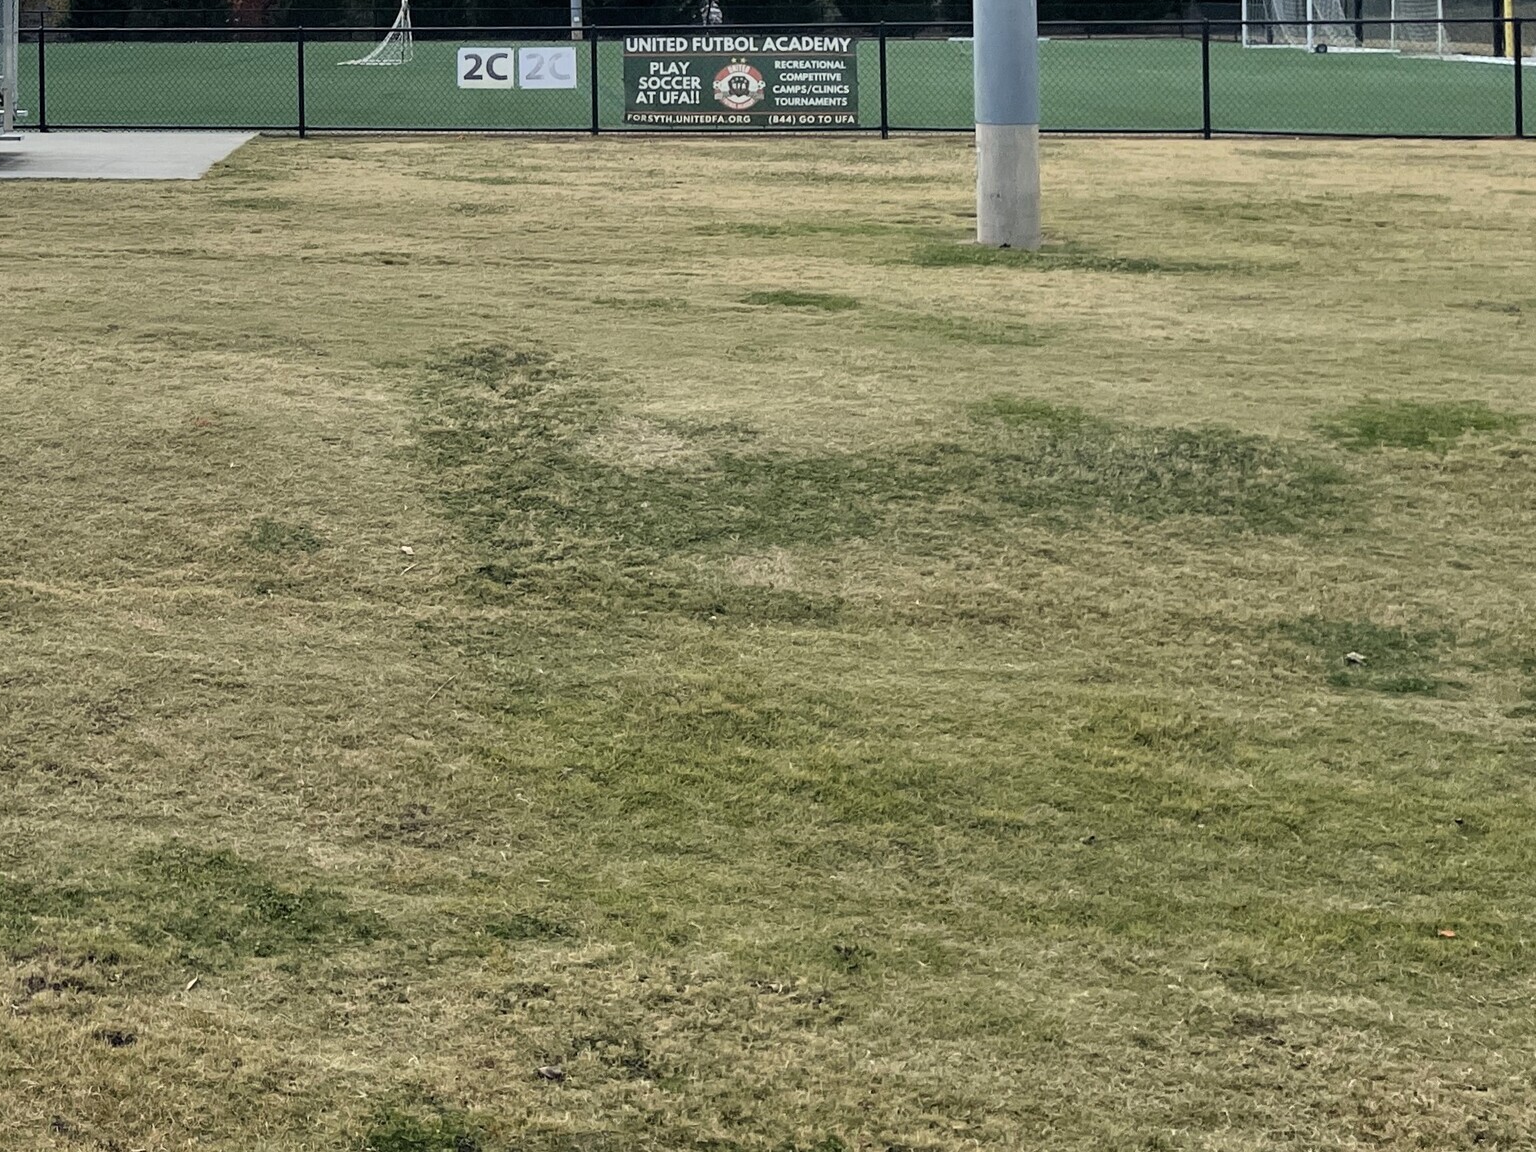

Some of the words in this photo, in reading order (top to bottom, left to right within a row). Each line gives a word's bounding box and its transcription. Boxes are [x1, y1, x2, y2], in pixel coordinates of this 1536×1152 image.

[626, 37, 688, 52] UNITED
[692, 36, 758, 52] FUTBOL
[762, 36, 851, 52] ACADEMY
[464, 53, 508, 80] 2C
[525, 53, 571, 80] 2C
[649, 62, 690, 75] PLAY
[774, 60, 846, 69] RECREATIONAL
[779, 73, 842, 81] COMPETITIVE
[638, 76, 702, 90] SOCCER
[772, 85, 849, 94] CAMPS/CLINICS
[635, 91, 656, 104] AT
[659, 90, 700, 104] UFA!!
[774, 97, 848, 106] TOURNAMENTS
[627, 114, 751, 124] FORSYTH.UNITEDFA.ORG
[768, 115, 796, 125] (844)
[799, 115, 815, 124] GO
[818, 115, 832, 124] TO
[835, 115, 855, 124] UFA
